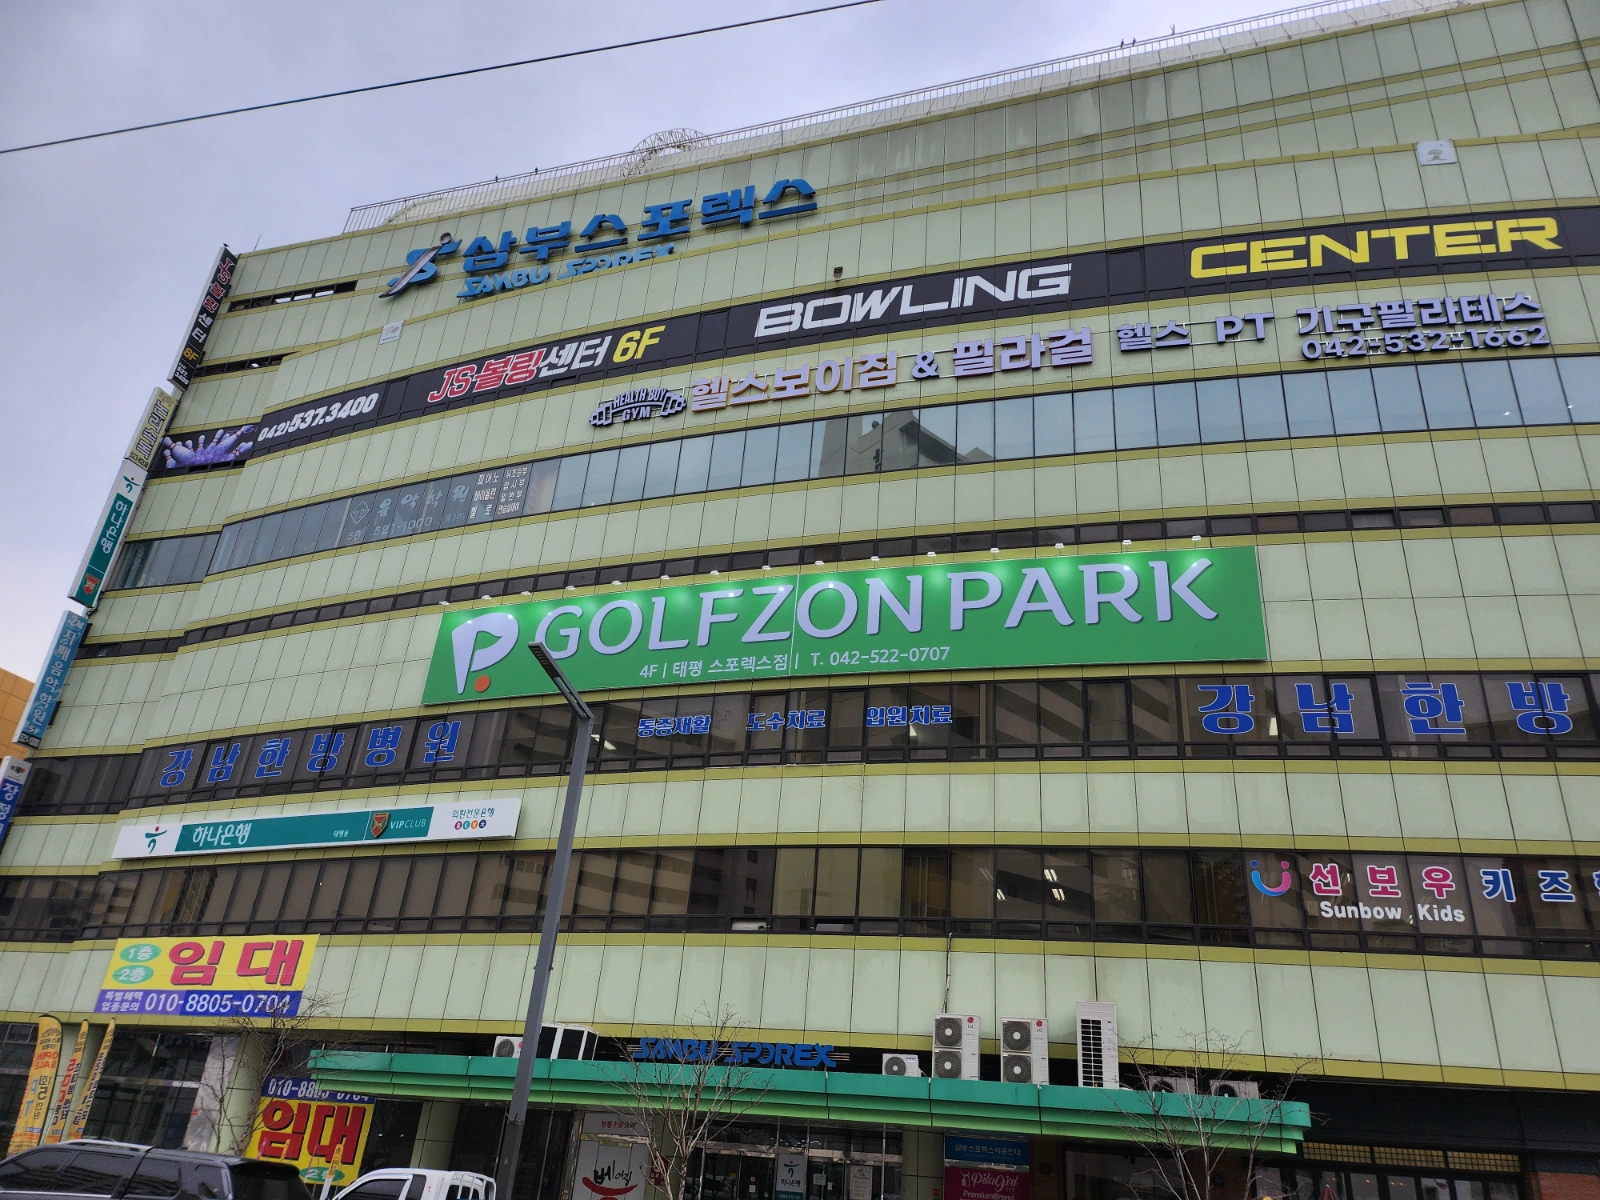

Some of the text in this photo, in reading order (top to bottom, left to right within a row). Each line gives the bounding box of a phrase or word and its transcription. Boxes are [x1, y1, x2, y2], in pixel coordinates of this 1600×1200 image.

[462, 178, 818, 273] 삼부스포렉스
[556, 242, 676, 281] SPOREX
[755, 216, 1561, 338] BOWLING CENTER
[1297, 292, 1545, 335] 기구필라테스
[1117, 312, 1275, 352] 헬스 PT
[1302, 324, 1551, 361] 042-532-1662
[183, 347, 199, 362] 6F
[427, 325, 667, 403] JS볼링센터 6F
[174, 371, 190, 385] 3400
[691, 327, 1094, 412] 헬스보이짐 & 필라걸
[613, 386, 669, 408] HEALTH BOY
[622, 405, 651, 422] GYM
[476, 473, 499, 485] 피아노
[474, 487, 496, 503] 바이올린
[100, 499, 128, 554] 하나은행
[373, 516, 433, 537] 521-1000
[534, 557, 1219, 664] GOLFZON PARK
[639, 646, 950, 679] 4F 태평 스포렉스점 T. 042-522-0707
[746, 710, 826, 731] 도수치료
[866, 705, 952, 727] 입원치료
[1197, 681, 1574, 735] 강남한방
[159, 720, 461, 788] 강남한방병원
[452, 807, 495, 818] 외환전문은행
[192, 822, 251, 845] 하나은행
[1309, 862, 1600, 902] 선보우 키즈
[1320, 901, 1466, 923] Sunbow Kids
[128, 946, 153, 961] 1층
[168, 940, 304, 986] 임대
[118, 970, 147, 982] 2층
[145, 992, 290, 1014] 010-8805-0704
[723, 1042, 836, 1068] SPOREX
[258, 1100, 366, 1165] 임대
[971, 1172, 1019, 1192] PilaGirl
